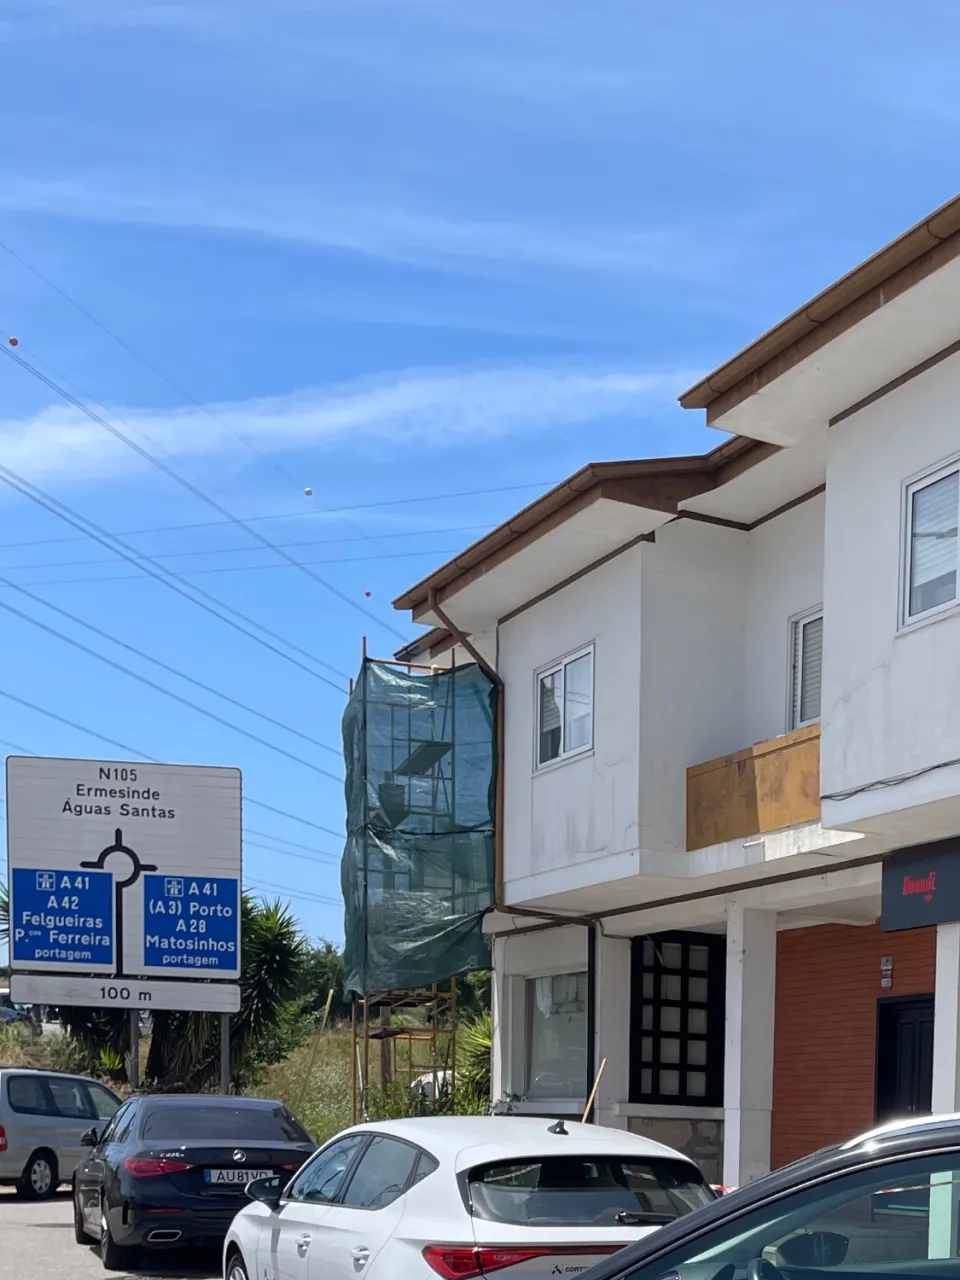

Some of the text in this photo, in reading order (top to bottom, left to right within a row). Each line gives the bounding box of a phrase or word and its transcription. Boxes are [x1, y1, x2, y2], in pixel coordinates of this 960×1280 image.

[76, 783, 160, 800] Ermesinde
[62, 797, 176, 819] Águas Santas
[189, 902, 233, 917] Porto
[22, 911, 103, 929] Felgueiras
[49, 930, 110, 946] Ferreira
[145, 934, 235, 952] Matosinhos
[34, 948, 92, 961] portagem
[162, 954, 219, 967] portagem
[100, 986, 152, 1001] 100 m
